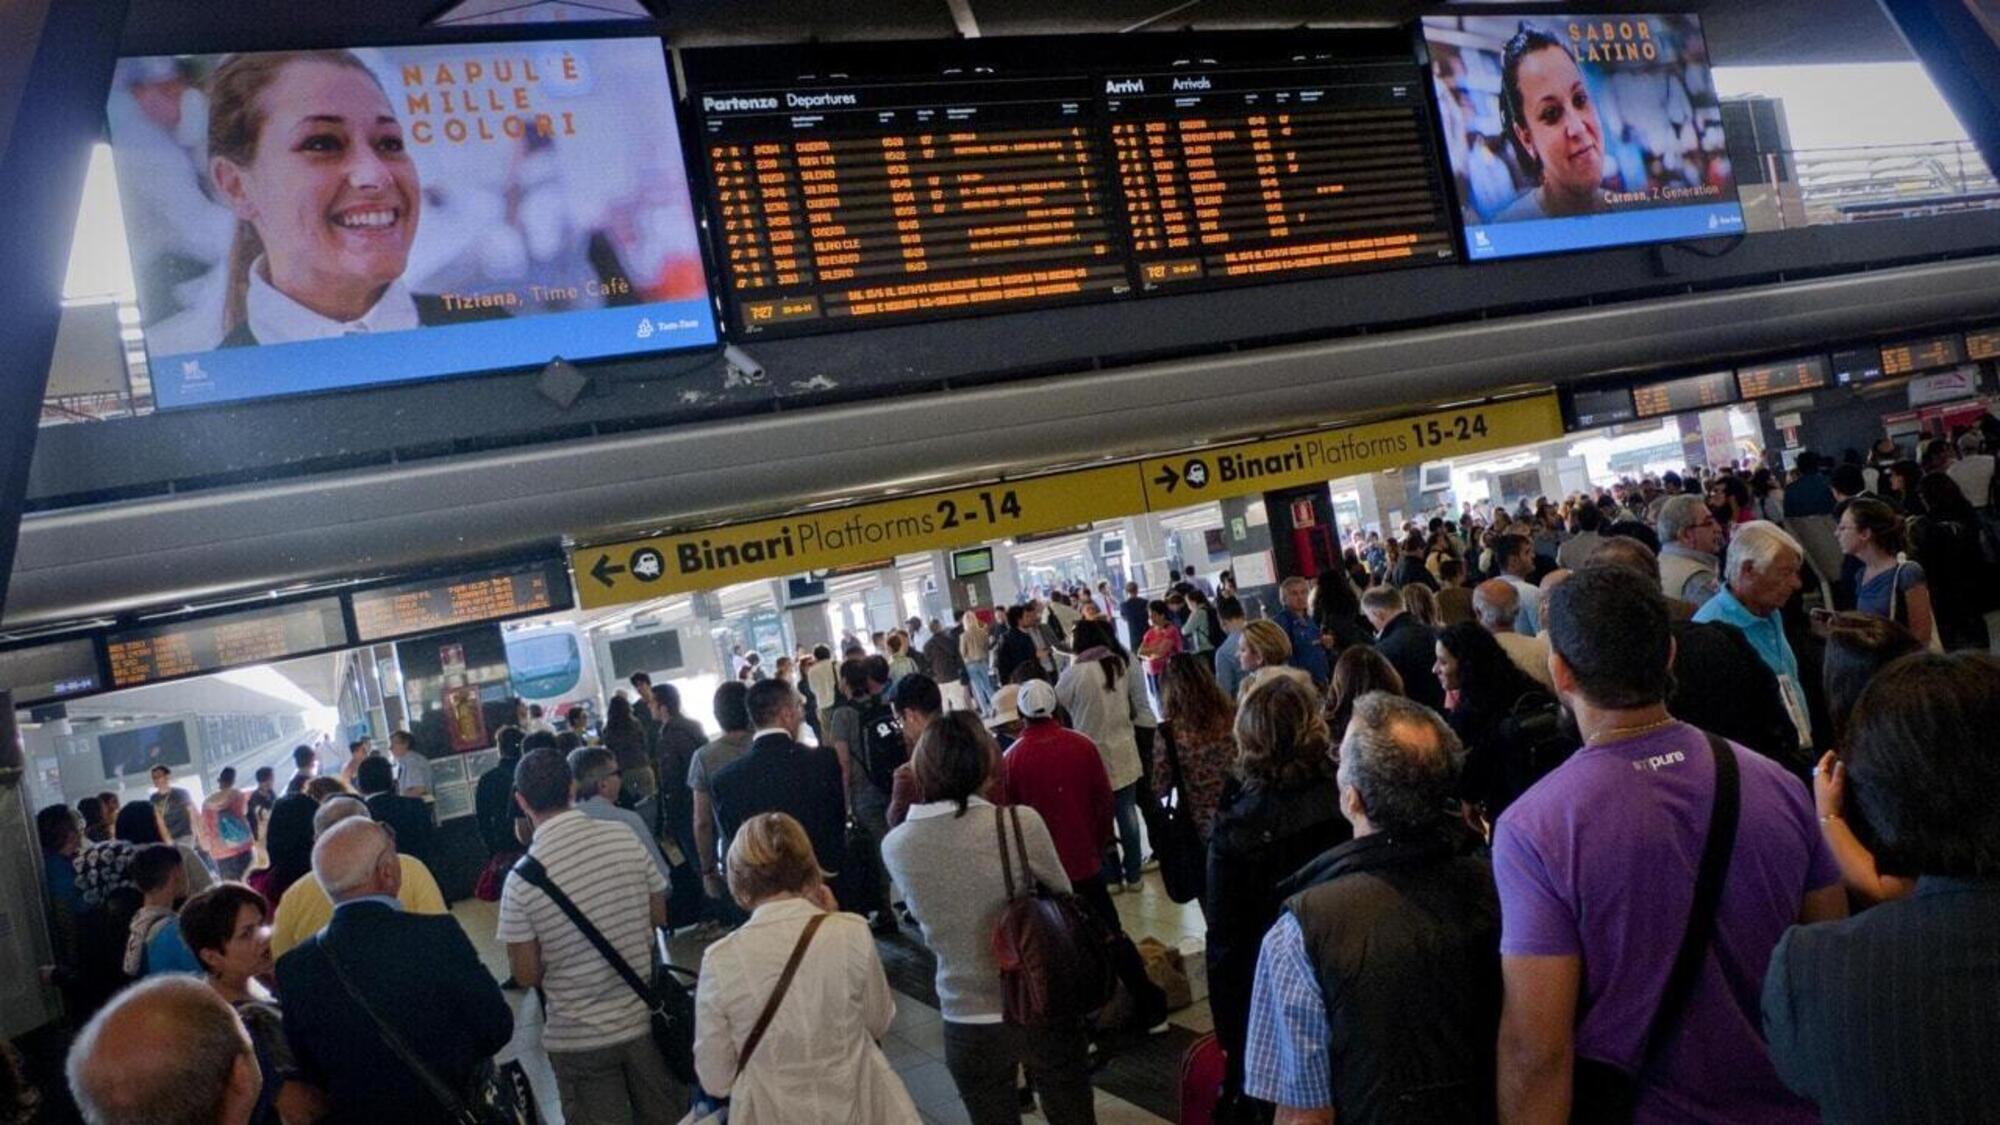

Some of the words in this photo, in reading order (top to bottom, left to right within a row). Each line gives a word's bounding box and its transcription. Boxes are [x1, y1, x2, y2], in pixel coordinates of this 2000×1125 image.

[1569, 21, 1651, 41] SABOR
[1573, 41, 1656, 62] LATINO
[1106, 78, 1145, 94] Arrivi
[1173, 75, 1212, 91] Arrivals
[406, 86, 531, 115] MILLE
[703, 96, 778, 112] Partenze
[786, 93, 857, 108] Departures
[411, 111, 576, 144] COLORI
[1604, 189, 1651, 204] Carmen,
[1662, 182, 1721, 200] Generation
[439, 292, 525, 311] Tiziana,
[529, 285, 578, 302] Time
[1217, 443, 1305, 483] Binari
[1306, 432, 1409, 467] Platforms
[1412, 413, 1489, 449] 15-24
[677, 525, 795, 574] Binari
[797, 513, 935, 554] Platforms
[937, 490, 1022, 530] 2-14
